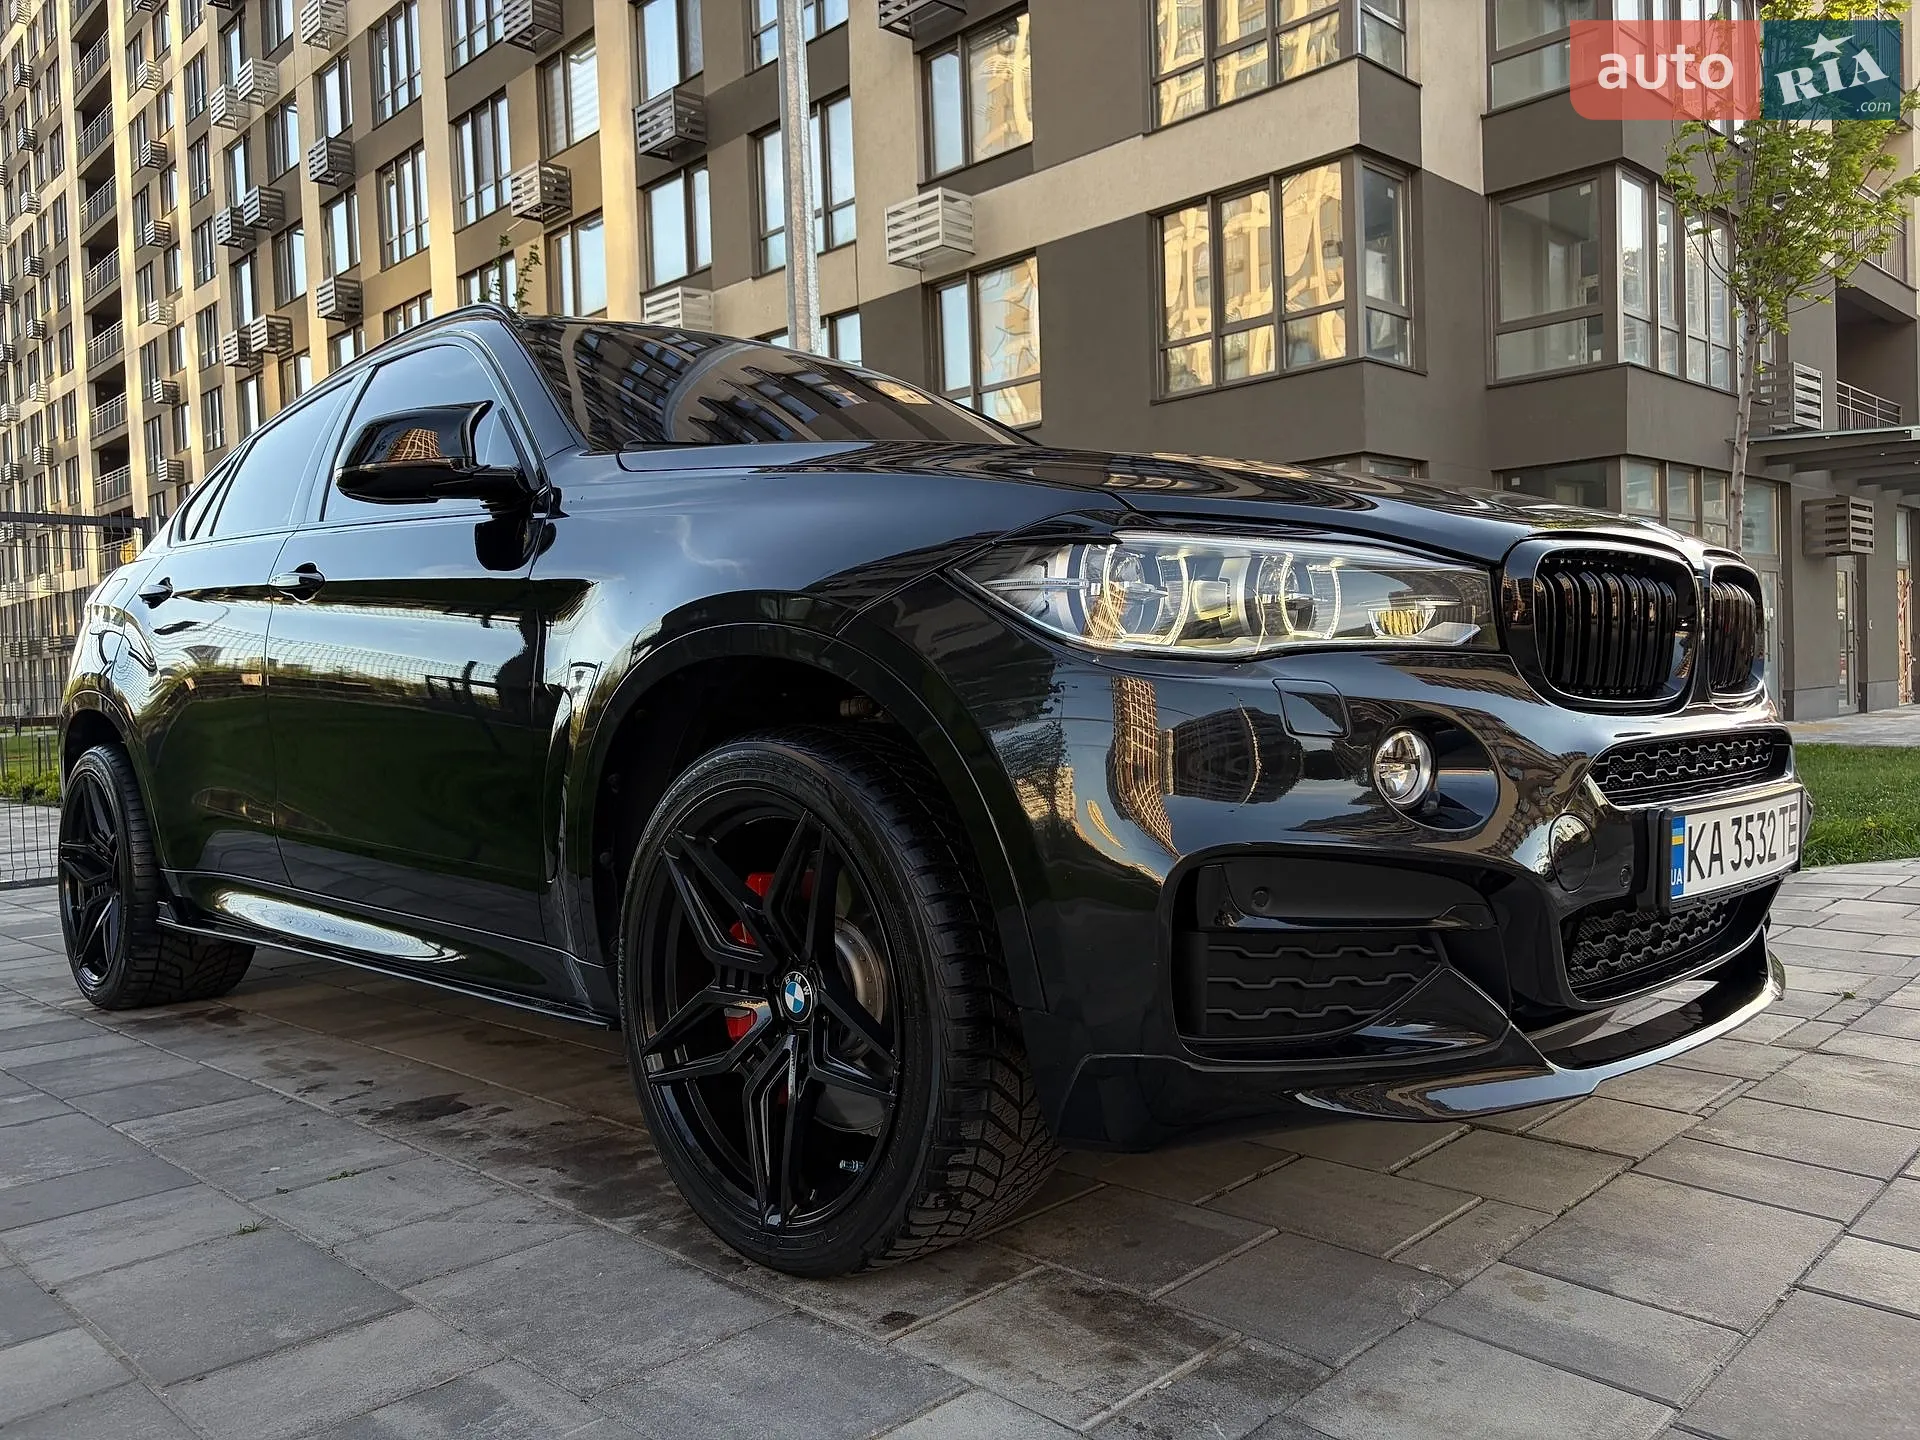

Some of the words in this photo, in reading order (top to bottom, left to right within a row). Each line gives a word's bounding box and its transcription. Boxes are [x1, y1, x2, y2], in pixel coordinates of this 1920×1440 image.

[1687, 821, 1724, 882] KA
[1730, 810, 1777, 871] 3532
[1778, 802, 1798, 857] TE
[1671, 870, 1683, 886] UA
